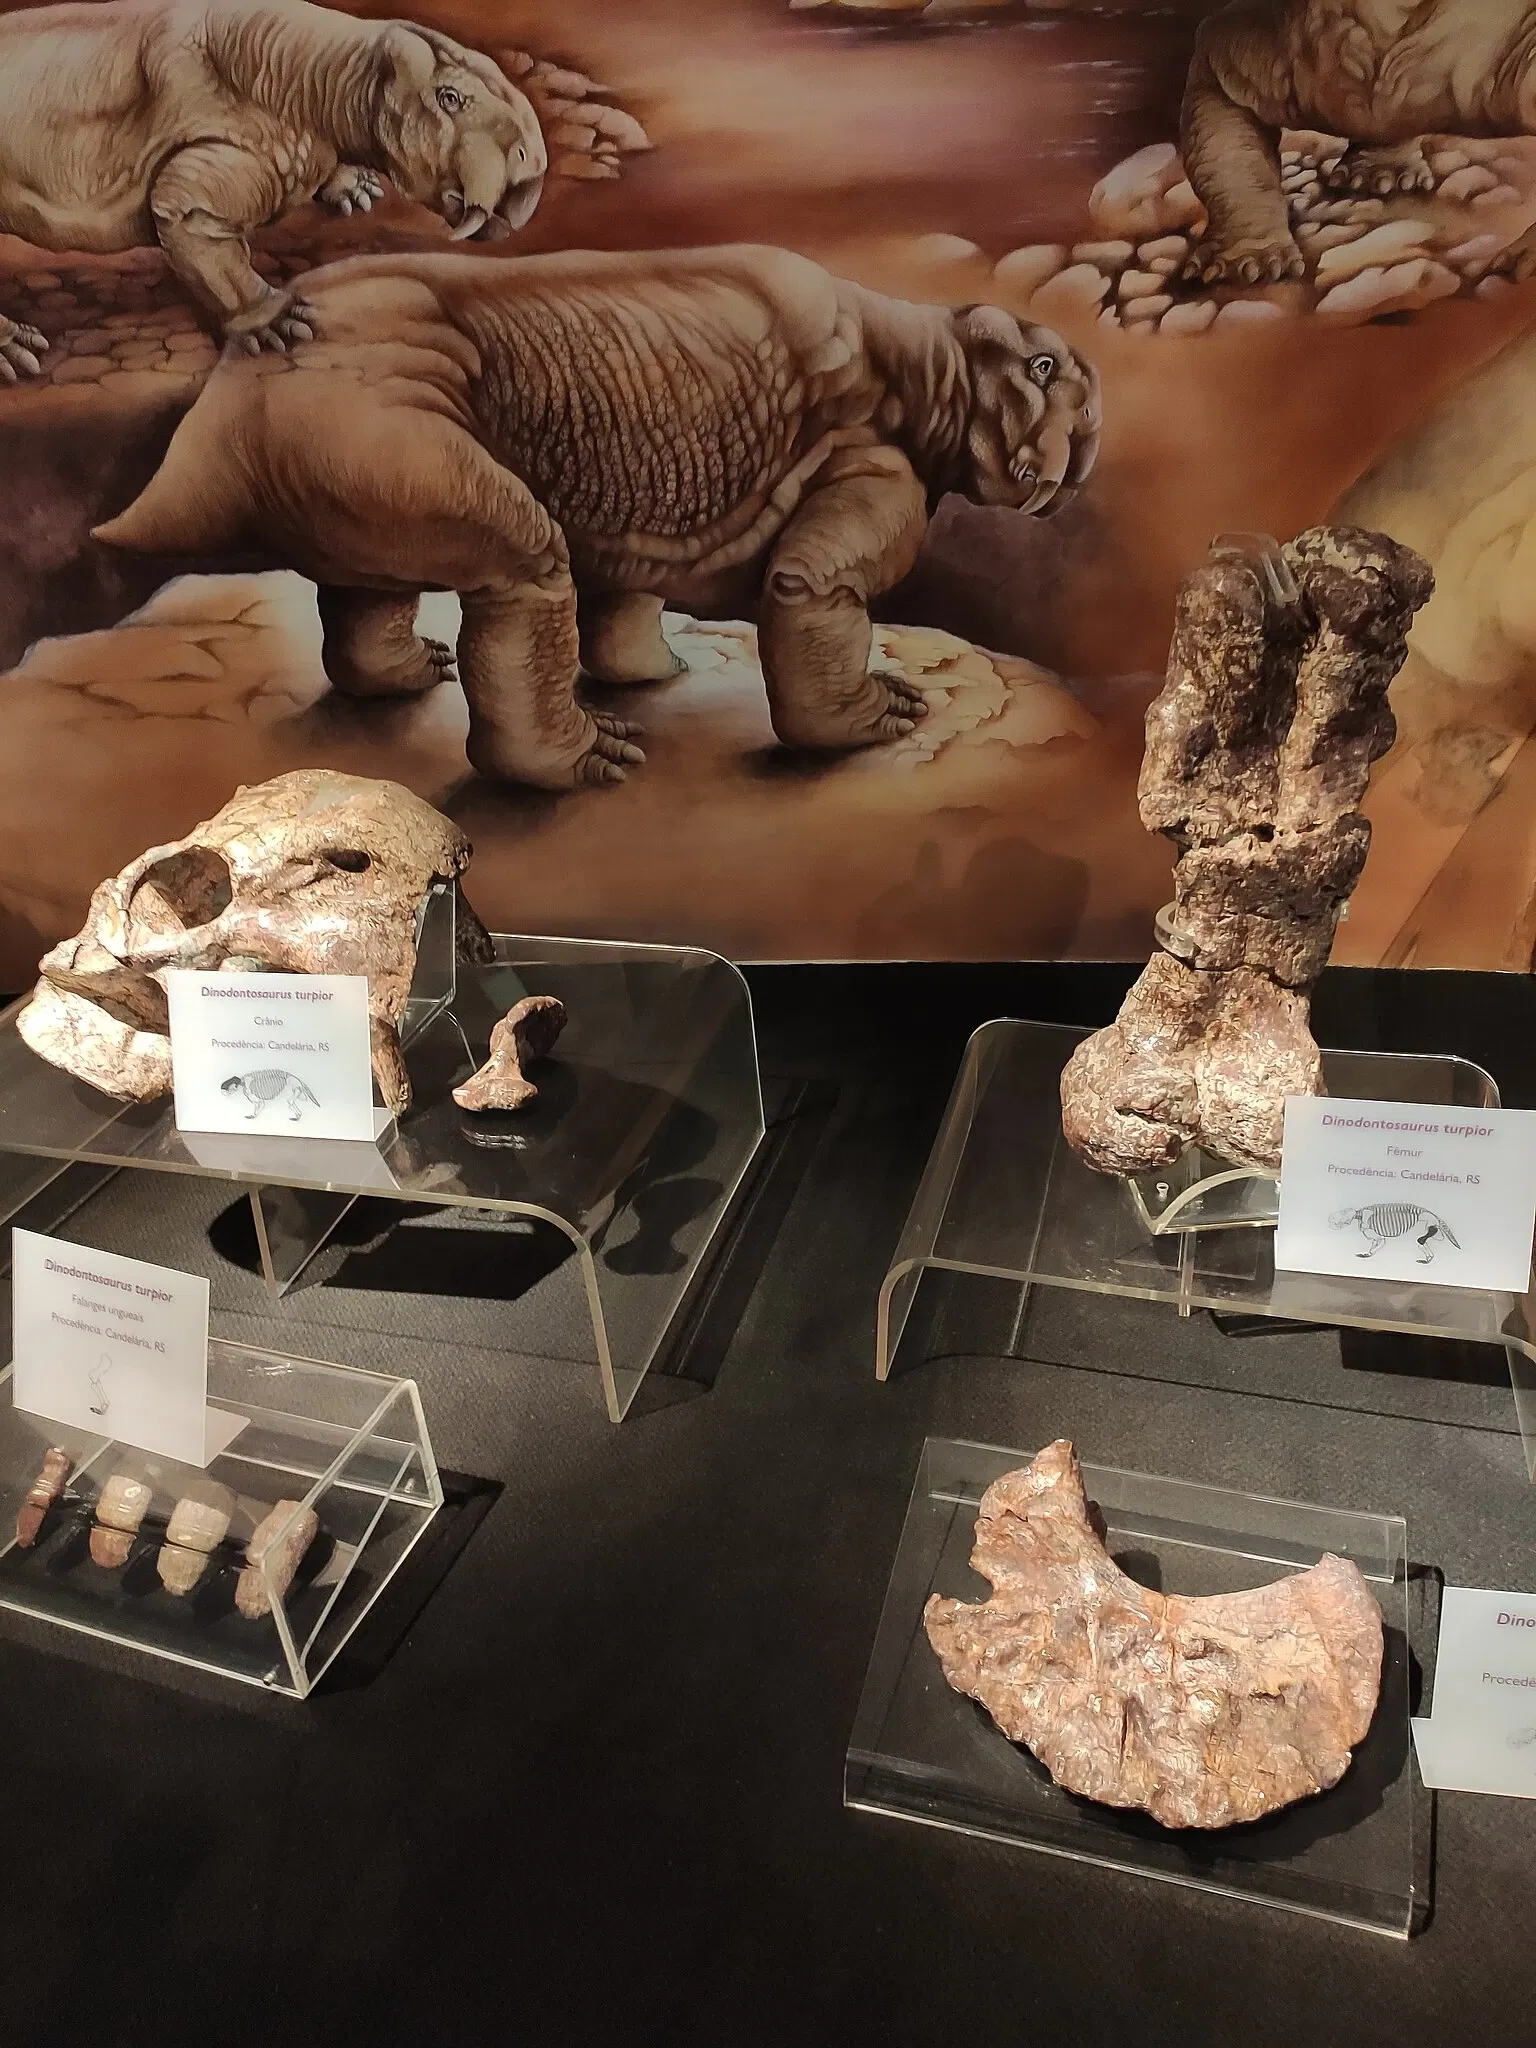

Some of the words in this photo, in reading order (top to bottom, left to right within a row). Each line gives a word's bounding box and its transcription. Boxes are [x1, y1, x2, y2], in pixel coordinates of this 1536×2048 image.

[201, 986, 292, 1000] Dinodontosaurus
[295, 990, 334, 1003] turpior
[253, 1016, 284, 1026] Crânio
[211, 1039, 266, 1049] Procedência:
[268, 1041, 316, 1052] Candelária,
[318, 1042, 330, 1051] RS
[1322, 1114, 1439, 1133] Dinodontosaurus
[1444, 1124, 1494, 1138] turpior
[1327, 1164, 1397, 1178] Procedência:
[1400, 1169, 1462, 1184] Candelária,
[1466, 1174, 1481, 1185] RS
[44, 1258, 133, 1292] Dinodontosaurus
[135, 1285, 173, 1302] turpior
[71, 1294, 106, 1312] Falanges
[108, 1304, 144, 1322] ungueais
[154, 1340, 166, 1354] RS
[1496, 1612, 1536, 1628] Dino
